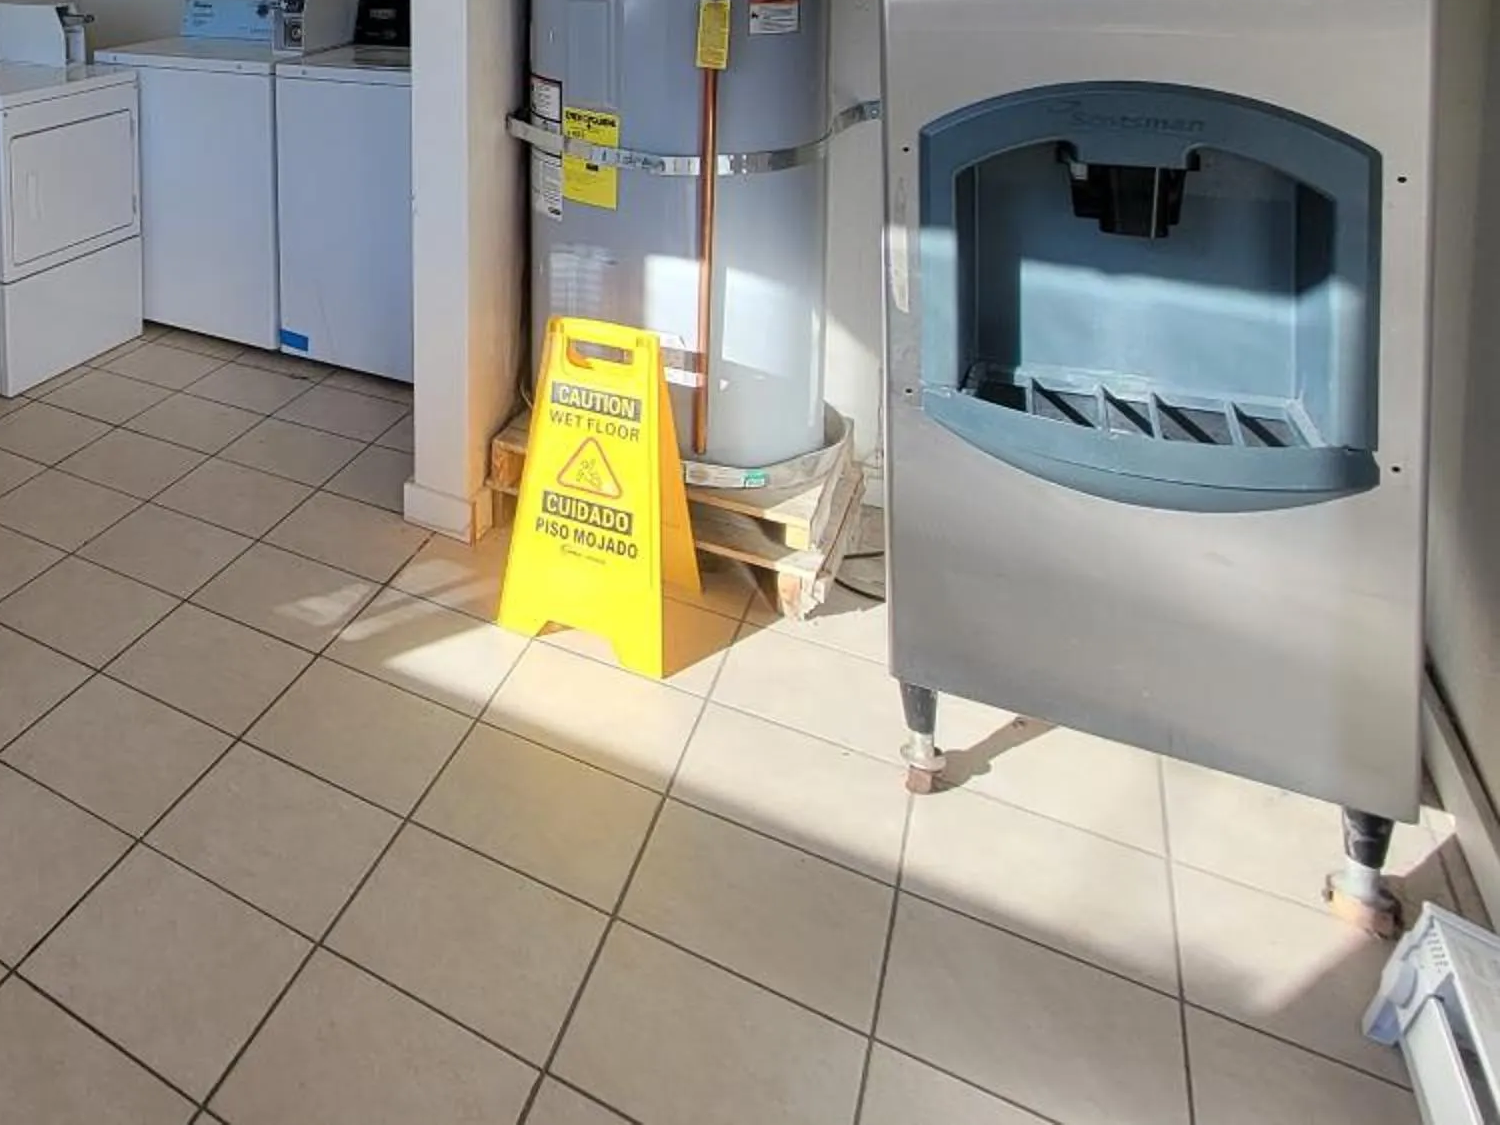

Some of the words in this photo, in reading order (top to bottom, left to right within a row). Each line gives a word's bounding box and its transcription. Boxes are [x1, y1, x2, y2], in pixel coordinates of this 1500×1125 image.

[558, 386, 637, 418] CAUTION
[550, 409, 583, 428] WET
[586, 417, 641, 443] FLOOR
[547, 494, 629, 532] CUIDADO
[535, 516, 569, 540] PISO
[573, 528, 638, 559] MOJADO
